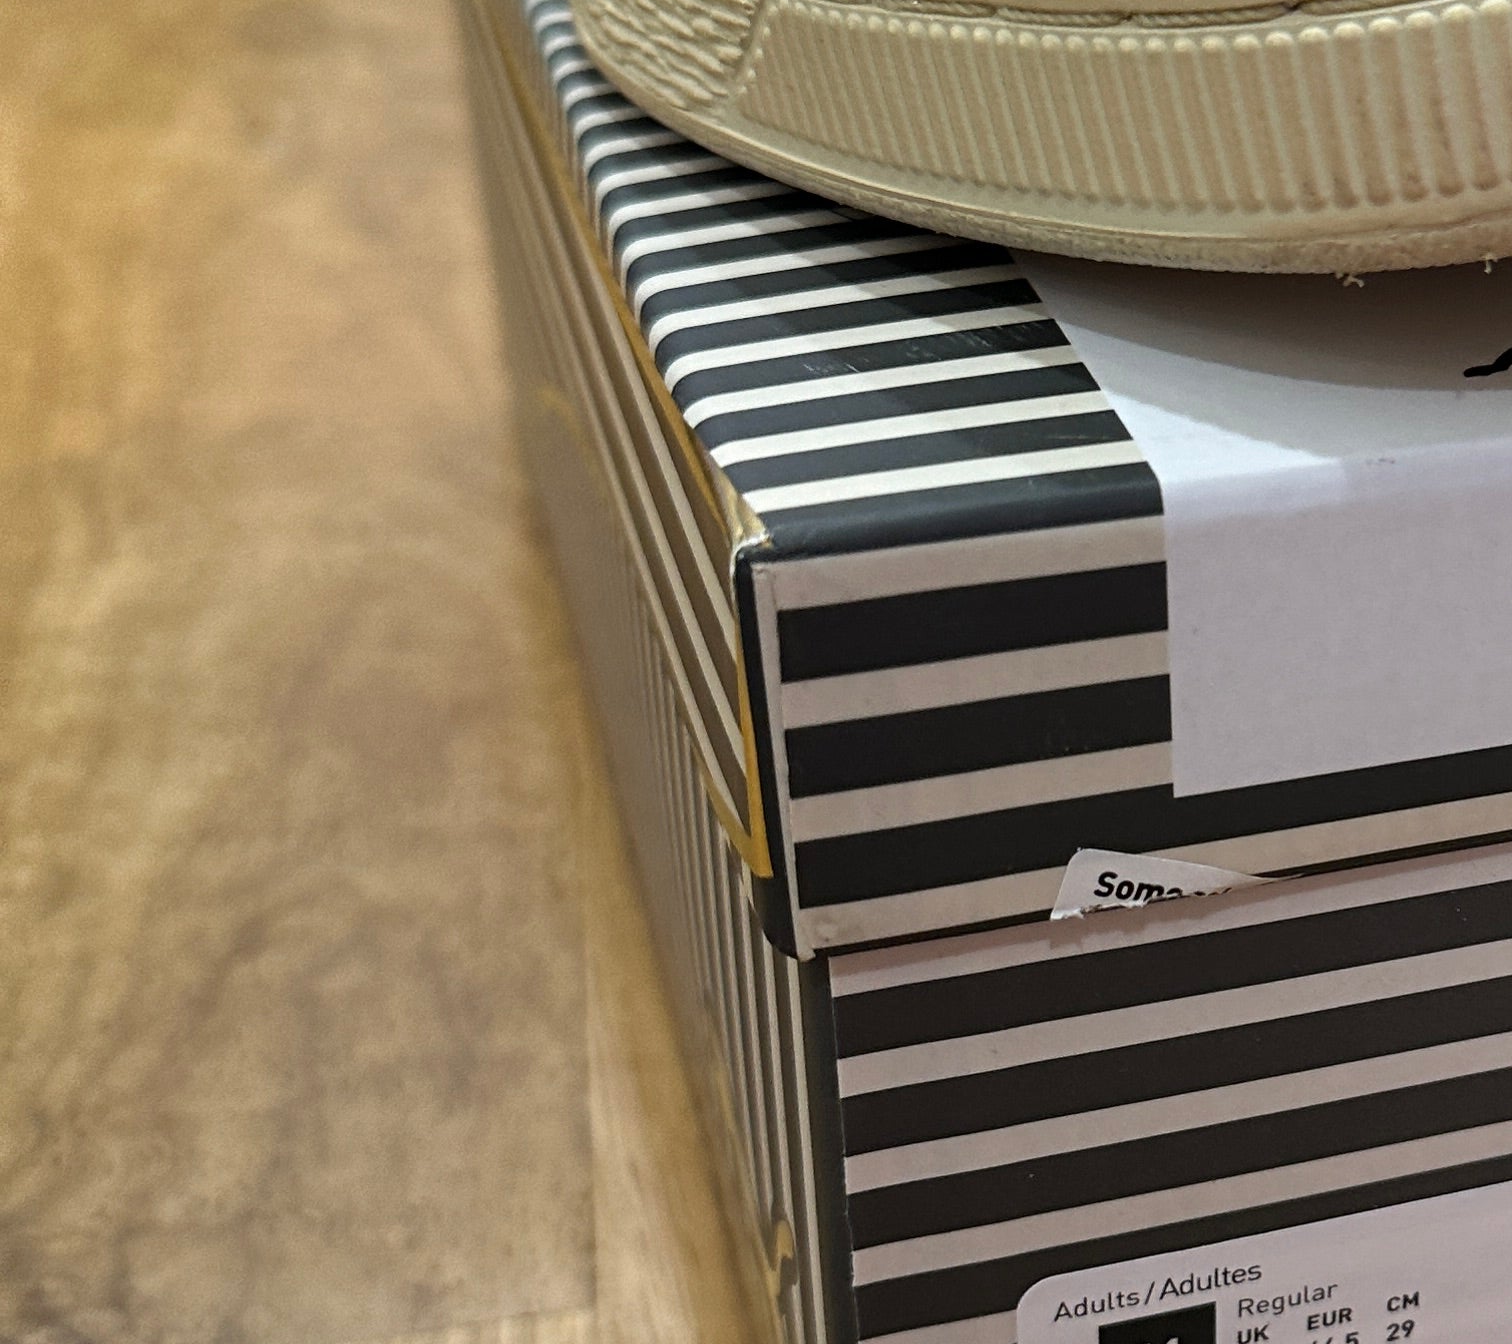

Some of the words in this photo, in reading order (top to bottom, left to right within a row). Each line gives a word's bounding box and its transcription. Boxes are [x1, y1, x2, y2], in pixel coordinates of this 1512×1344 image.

[1237, 1282, 1338, 1318] Regular
[1307, 1307, 1353, 1331] EUR
[1386, 1291, 1420, 1313] CM
[1385, 1319, 1415, 1343] 29
